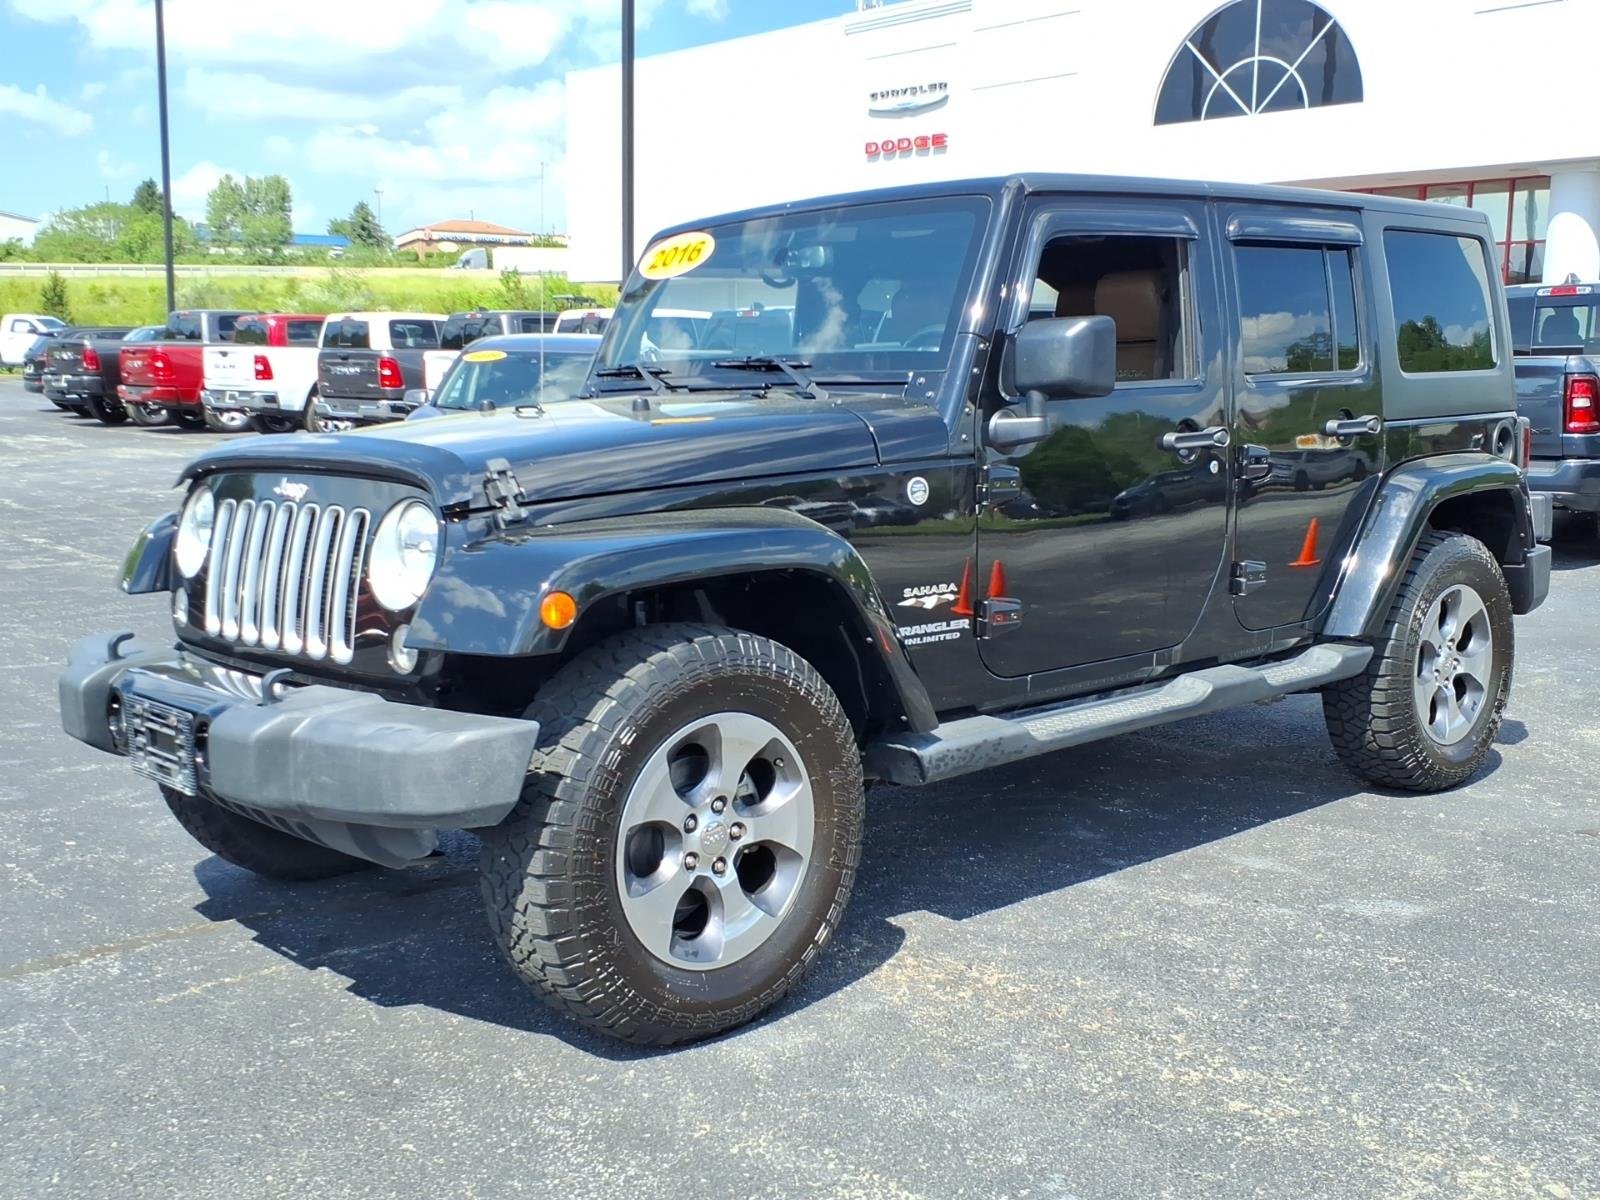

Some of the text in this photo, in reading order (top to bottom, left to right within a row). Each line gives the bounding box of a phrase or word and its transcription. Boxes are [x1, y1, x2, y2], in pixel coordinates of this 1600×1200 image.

[869, 82, 948, 102] CHRYSLER
[865, 133, 948, 159] DODGE
[647, 240, 707, 271] 2016
[903, 582, 958, 598] SAHARA
[899, 618, 970, 636] RANGLER
